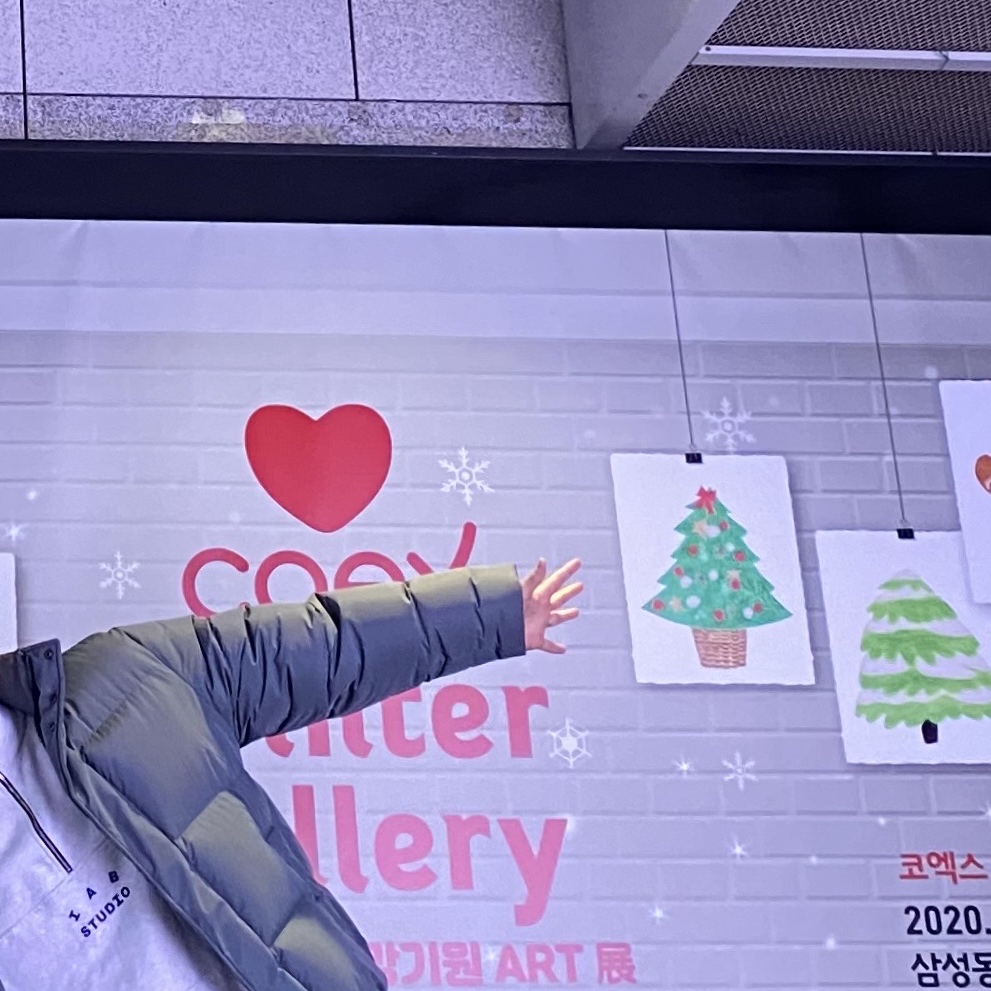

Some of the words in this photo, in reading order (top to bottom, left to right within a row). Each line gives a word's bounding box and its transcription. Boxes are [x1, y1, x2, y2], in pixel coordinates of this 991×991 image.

[292, 784, 569, 927] llery
[899, 851, 989, 885] 코엑스
[81, 887, 130, 937] STUDIO
[495, 942, 584, 984] ART
[595, 941, 638, 986] 展
